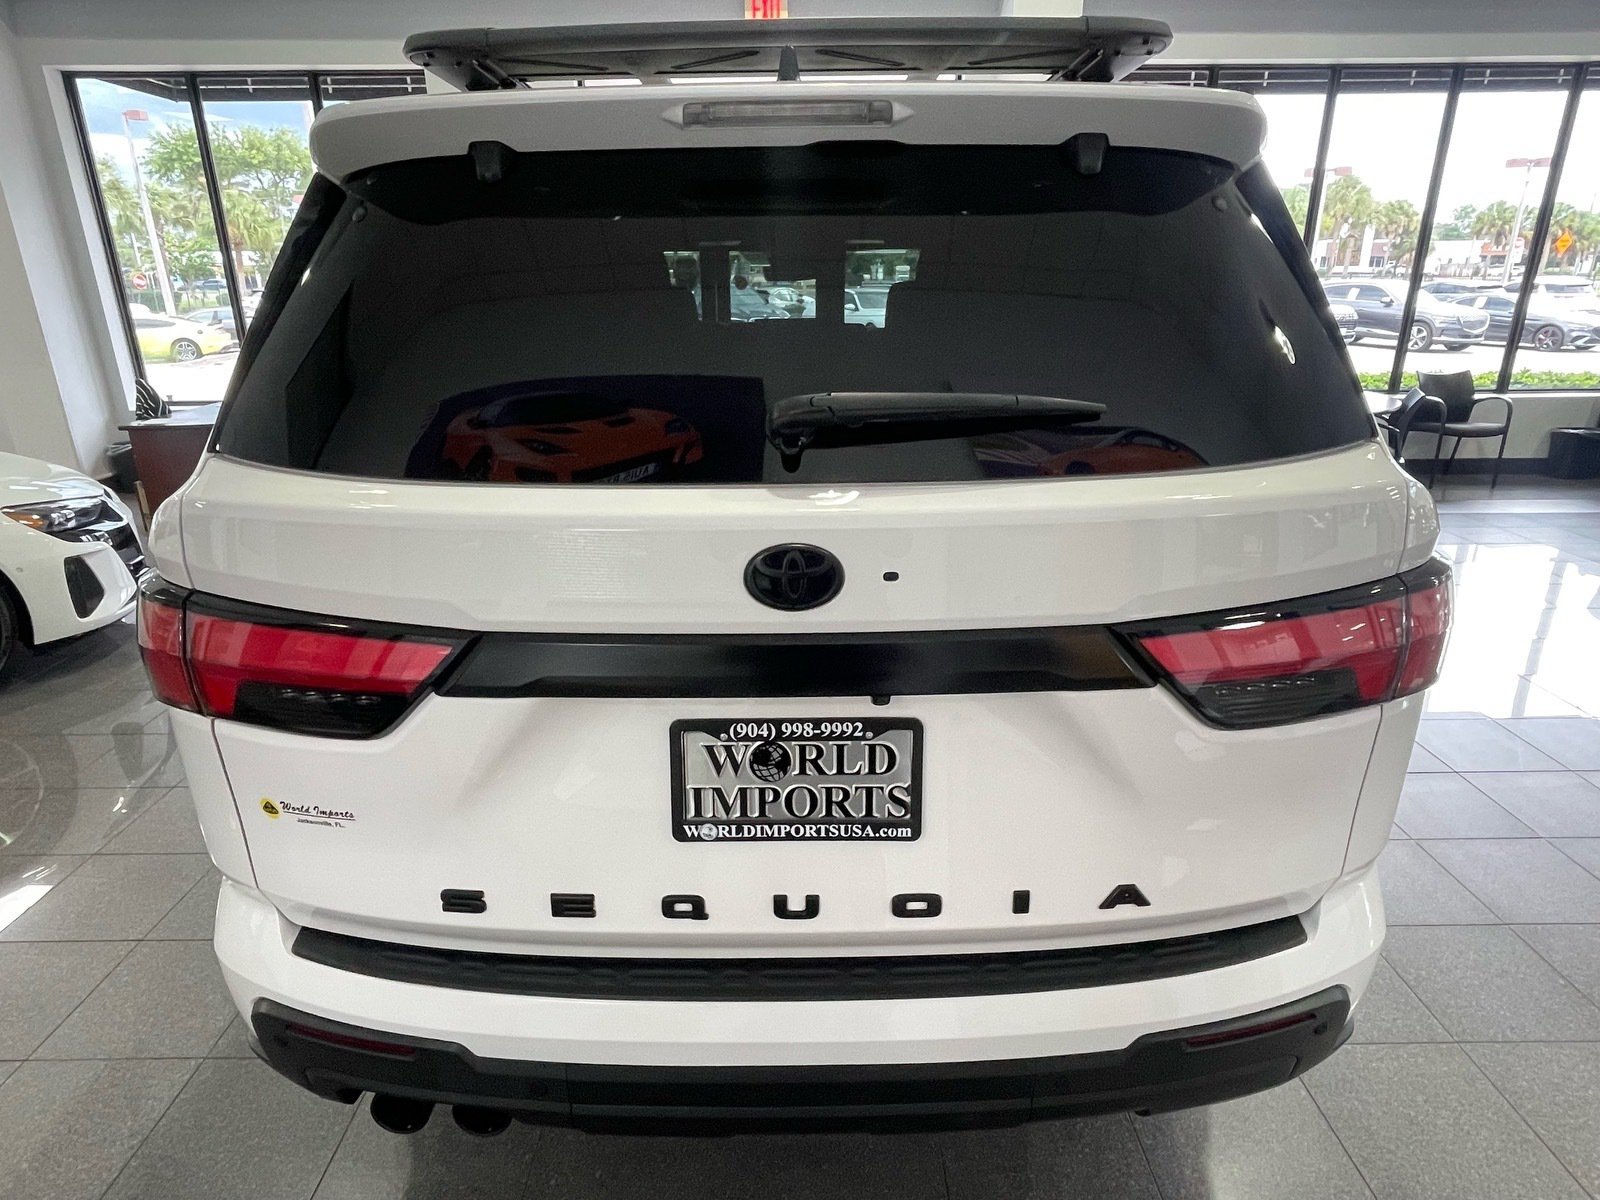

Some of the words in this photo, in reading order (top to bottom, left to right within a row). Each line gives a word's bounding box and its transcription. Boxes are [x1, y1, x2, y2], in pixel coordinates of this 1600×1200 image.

[729, 722, 776, 741] (904)
[781, 722, 863, 738] 998-9992
[701, 740, 898, 782] WORLD
[280, 801, 311, 814] World
[313, 806, 354, 818] Imports
[687, 785, 912, 819] IMPORTS
[683, 824, 912, 840] WORLDIMPORTSUSA.com
[440, 884, 1151, 920] SEQUOIA
